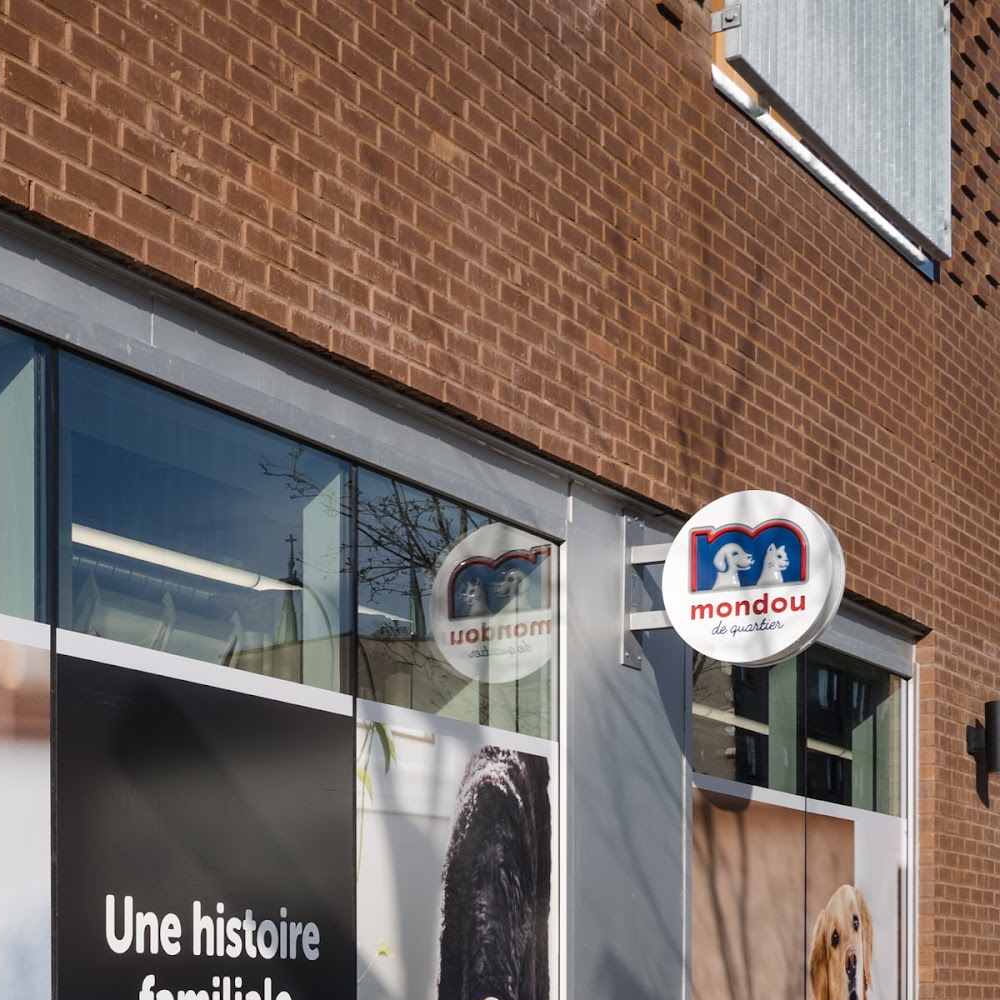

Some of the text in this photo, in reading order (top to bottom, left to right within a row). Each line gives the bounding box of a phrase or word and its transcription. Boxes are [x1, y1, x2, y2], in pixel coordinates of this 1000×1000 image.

[690, 593, 806, 621] mondou
[712, 618, 784, 638] de quartier
[105, 894, 321, 961] Une histoire
